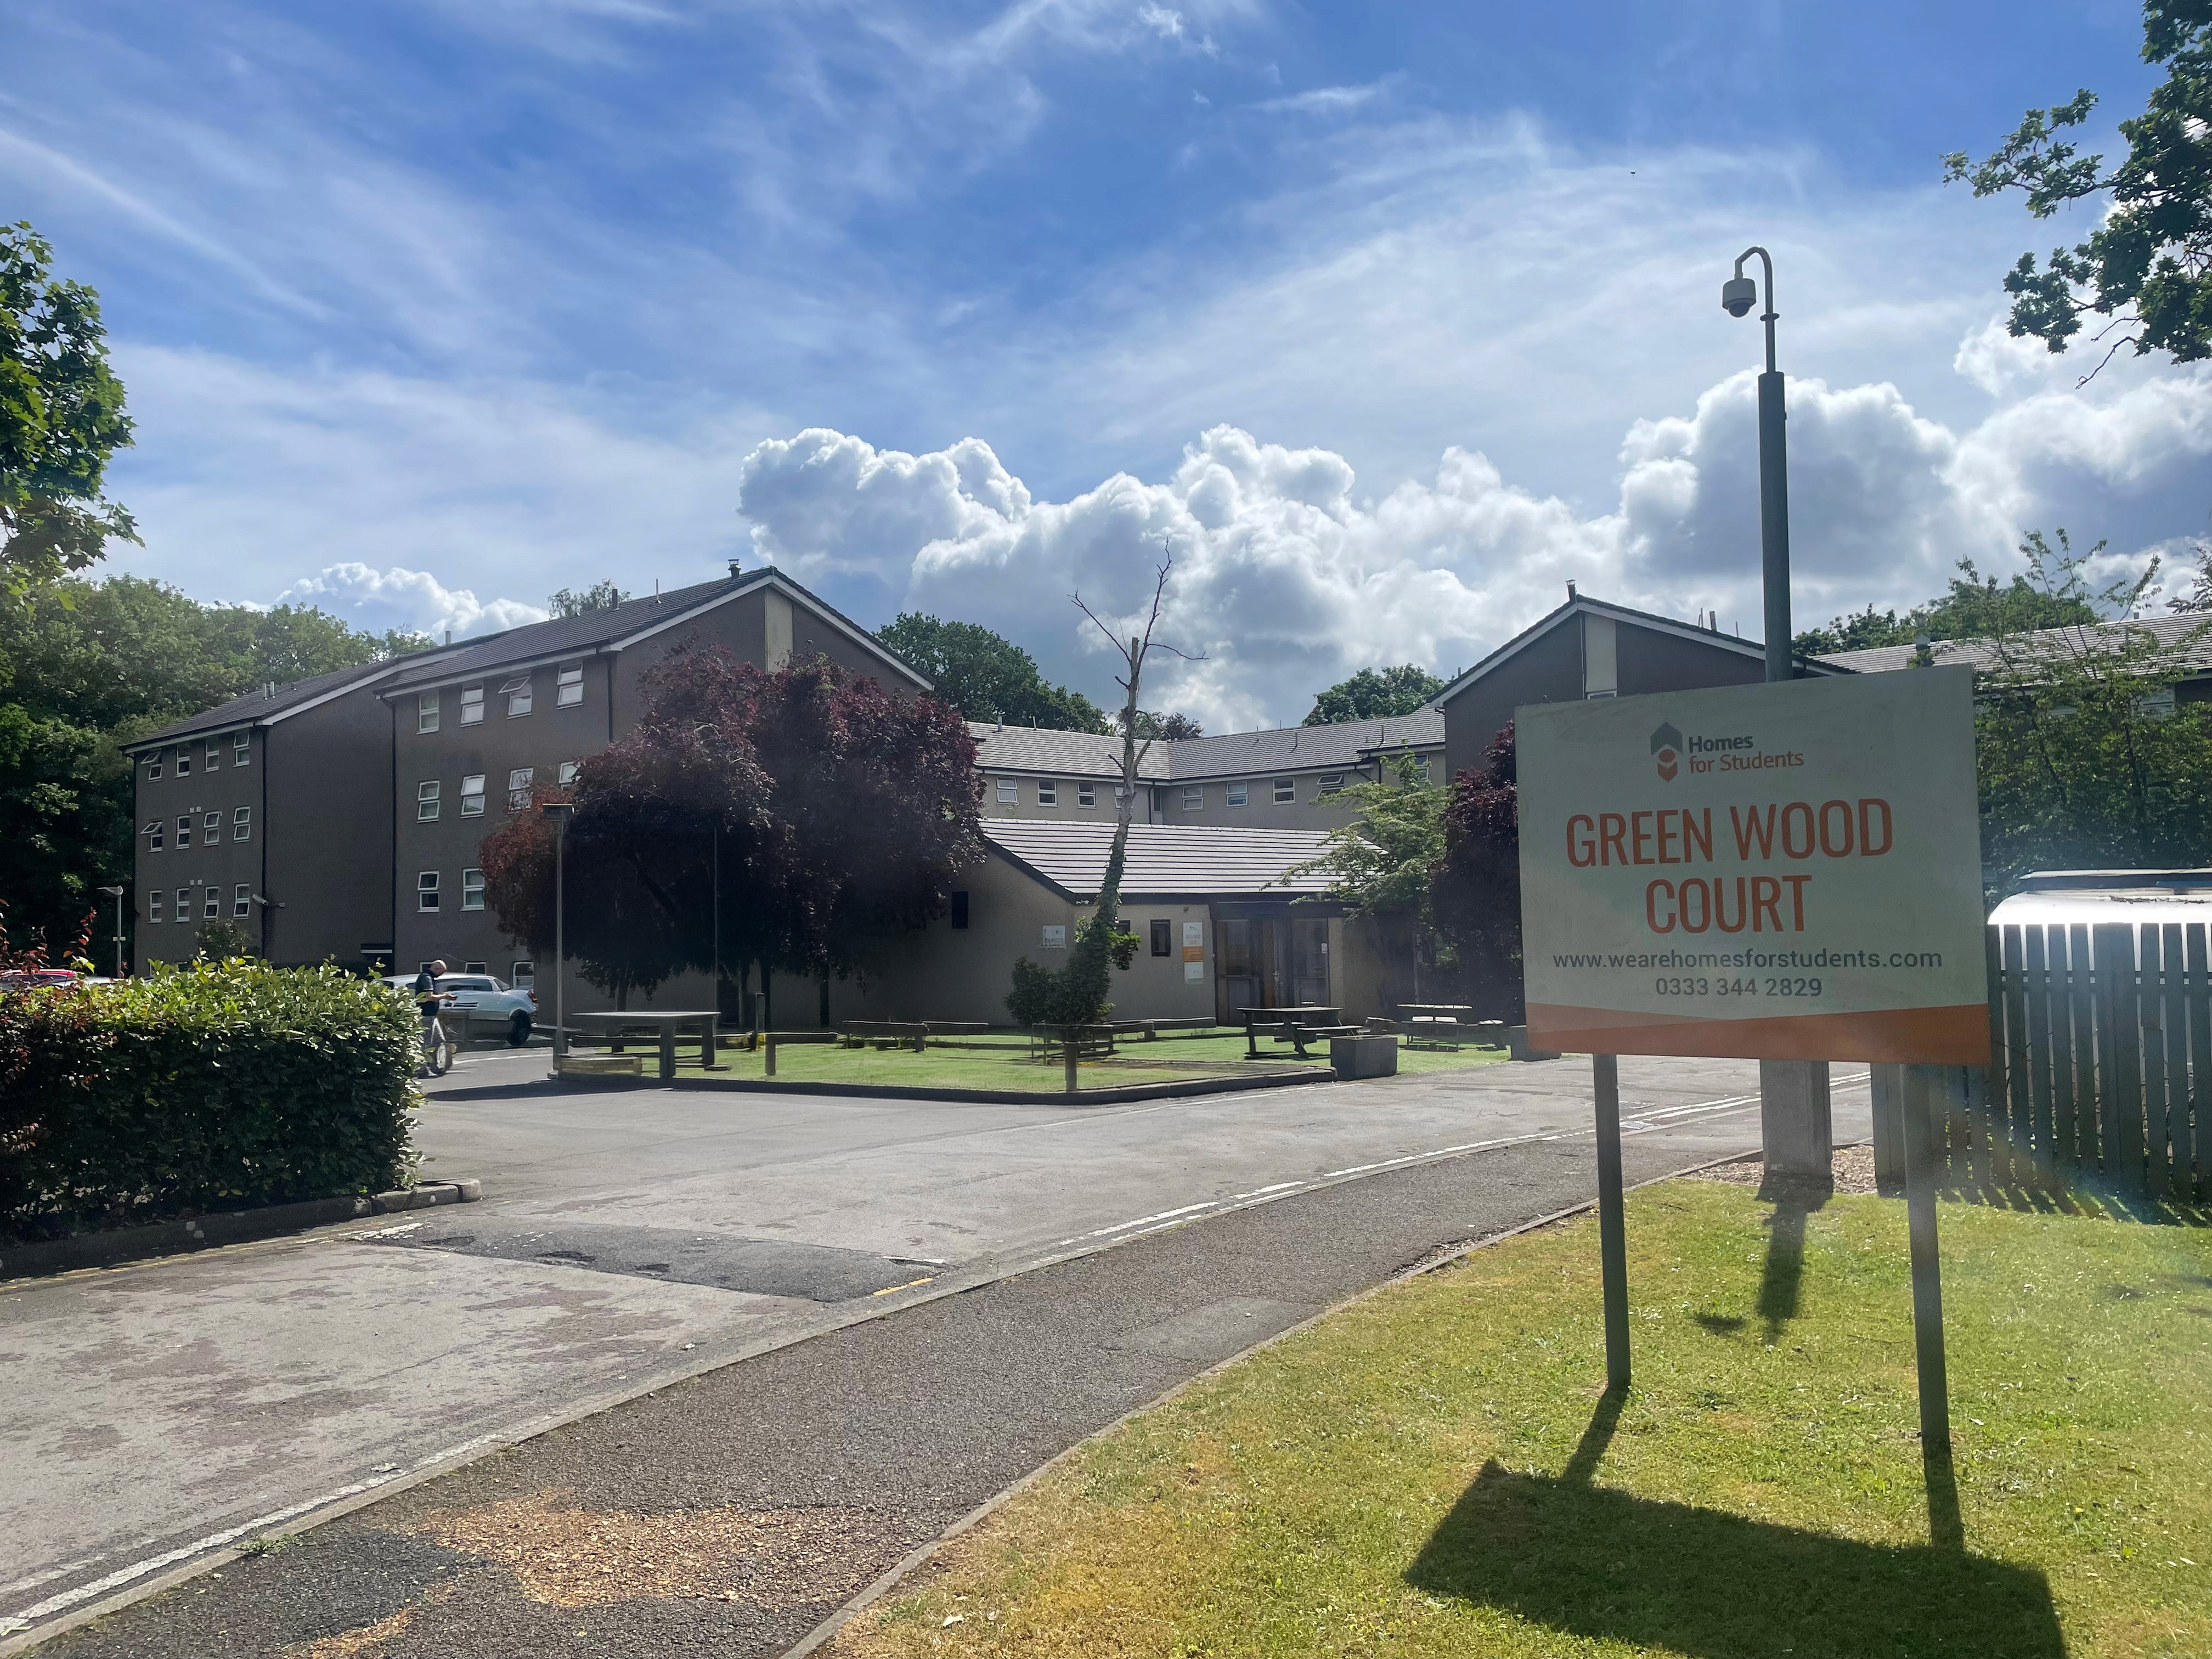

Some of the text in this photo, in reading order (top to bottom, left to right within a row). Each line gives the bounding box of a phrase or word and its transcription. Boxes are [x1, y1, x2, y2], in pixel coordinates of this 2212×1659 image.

[1689, 736, 1754, 753] Homes
[1689, 751, 1804, 774] for Students
[1566, 798, 1893, 868] GREEN WOOD
[1646, 874, 1813, 934] COURT
[1552, 947, 1943, 968] www.wearehomesforstudents.com
[1656, 978, 1822, 997] 0333 344 2829
